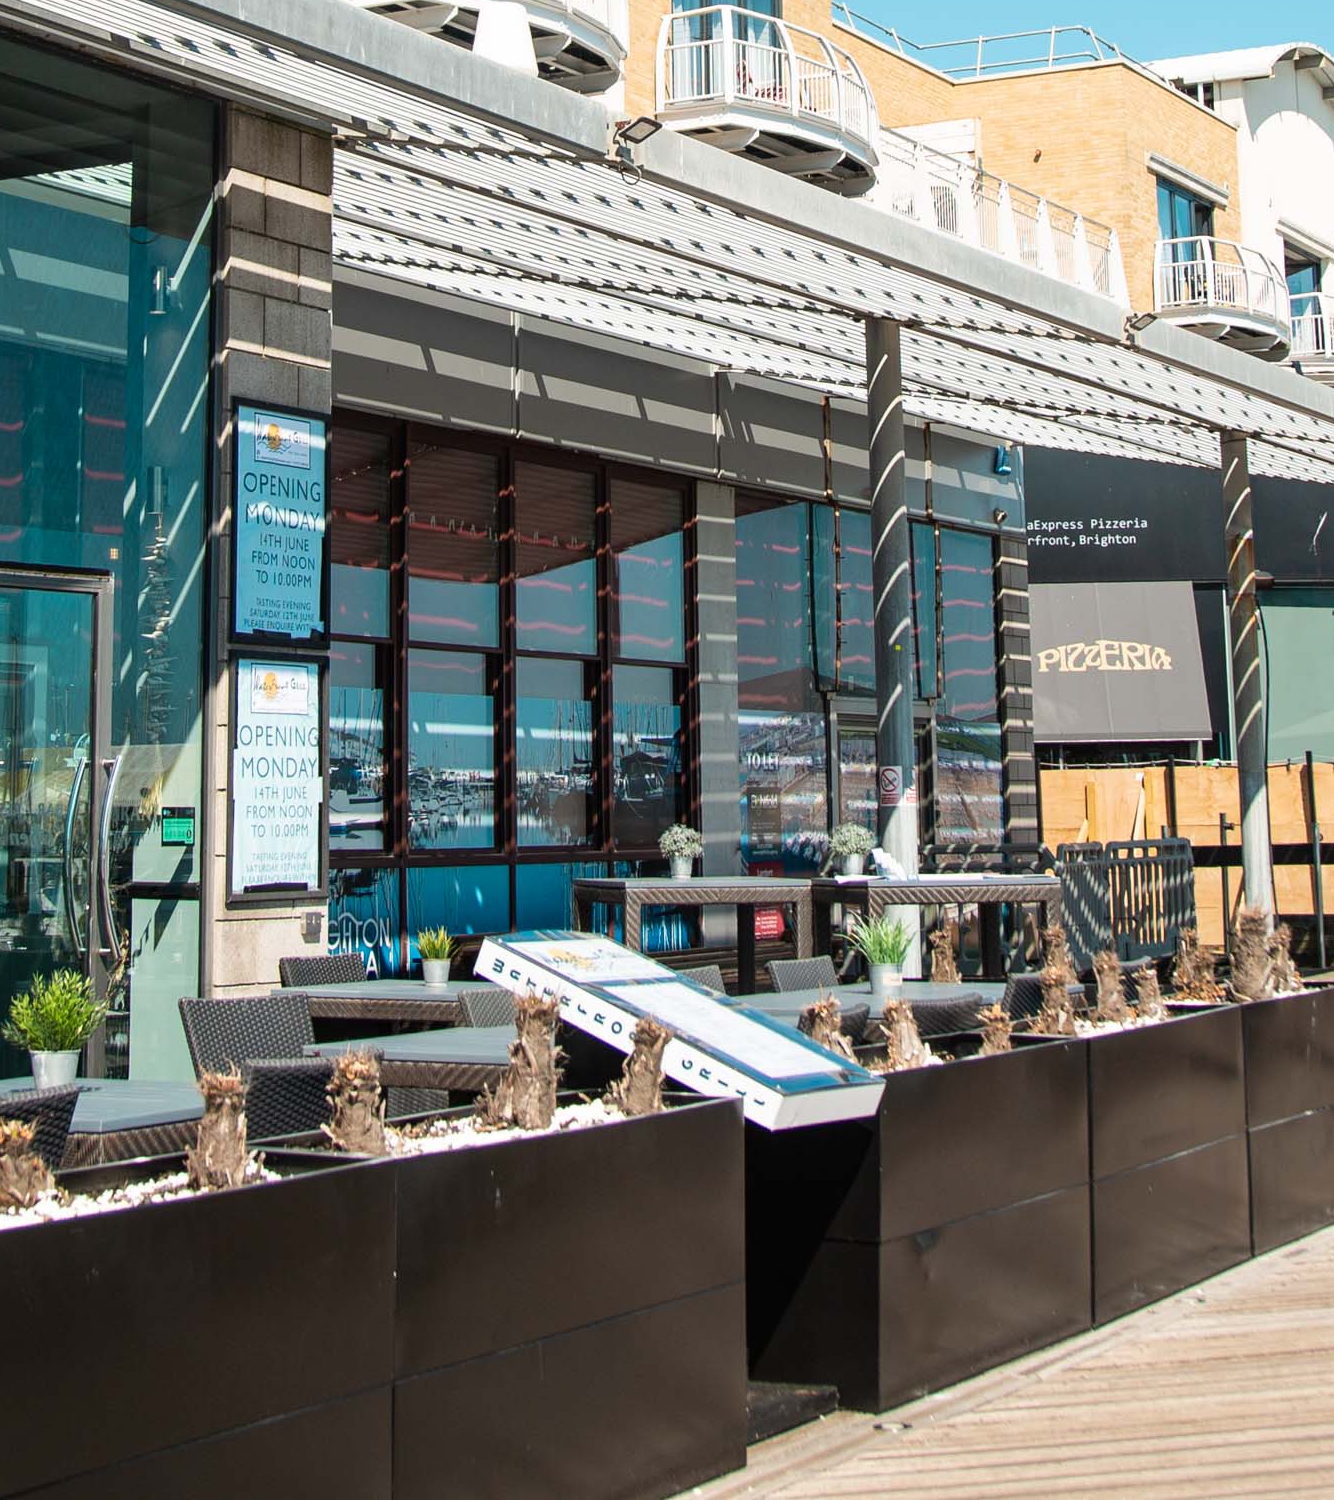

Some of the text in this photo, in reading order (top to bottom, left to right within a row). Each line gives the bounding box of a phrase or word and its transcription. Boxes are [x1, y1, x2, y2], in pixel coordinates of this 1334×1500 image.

[243, 471, 321, 502] OPENING
[245, 504, 319, 533] MONDAY
[1027, 517, 1148, 531] aExpress Pizzeria
[259, 533, 309, 553] 14TH JUNE
[1027, 533, 1137, 547] rfront, Brighton
[251, 550, 315, 571] FROM NOON
[256, 569, 312, 589] TO 10.00PM
[282, 600, 312, 610] EVENING
[1037, 640, 1172, 672] PIZZERIA
[239, 724, 319, 747] OPENING
[241, 756, 318, 779] MONDAY
[746, 752, 780, 771] TO LET
[253, 785, 308, 803] 14TH JUNE
[246, 804, 313, 819] FROM NOON
[251, 823, 309, 839] TO 10.00PM
[327, 912, 392, 954] GHTON
[492, 958, 638, 1041] WATERFRO
[682, 1059, 765, 1106] GRILL
